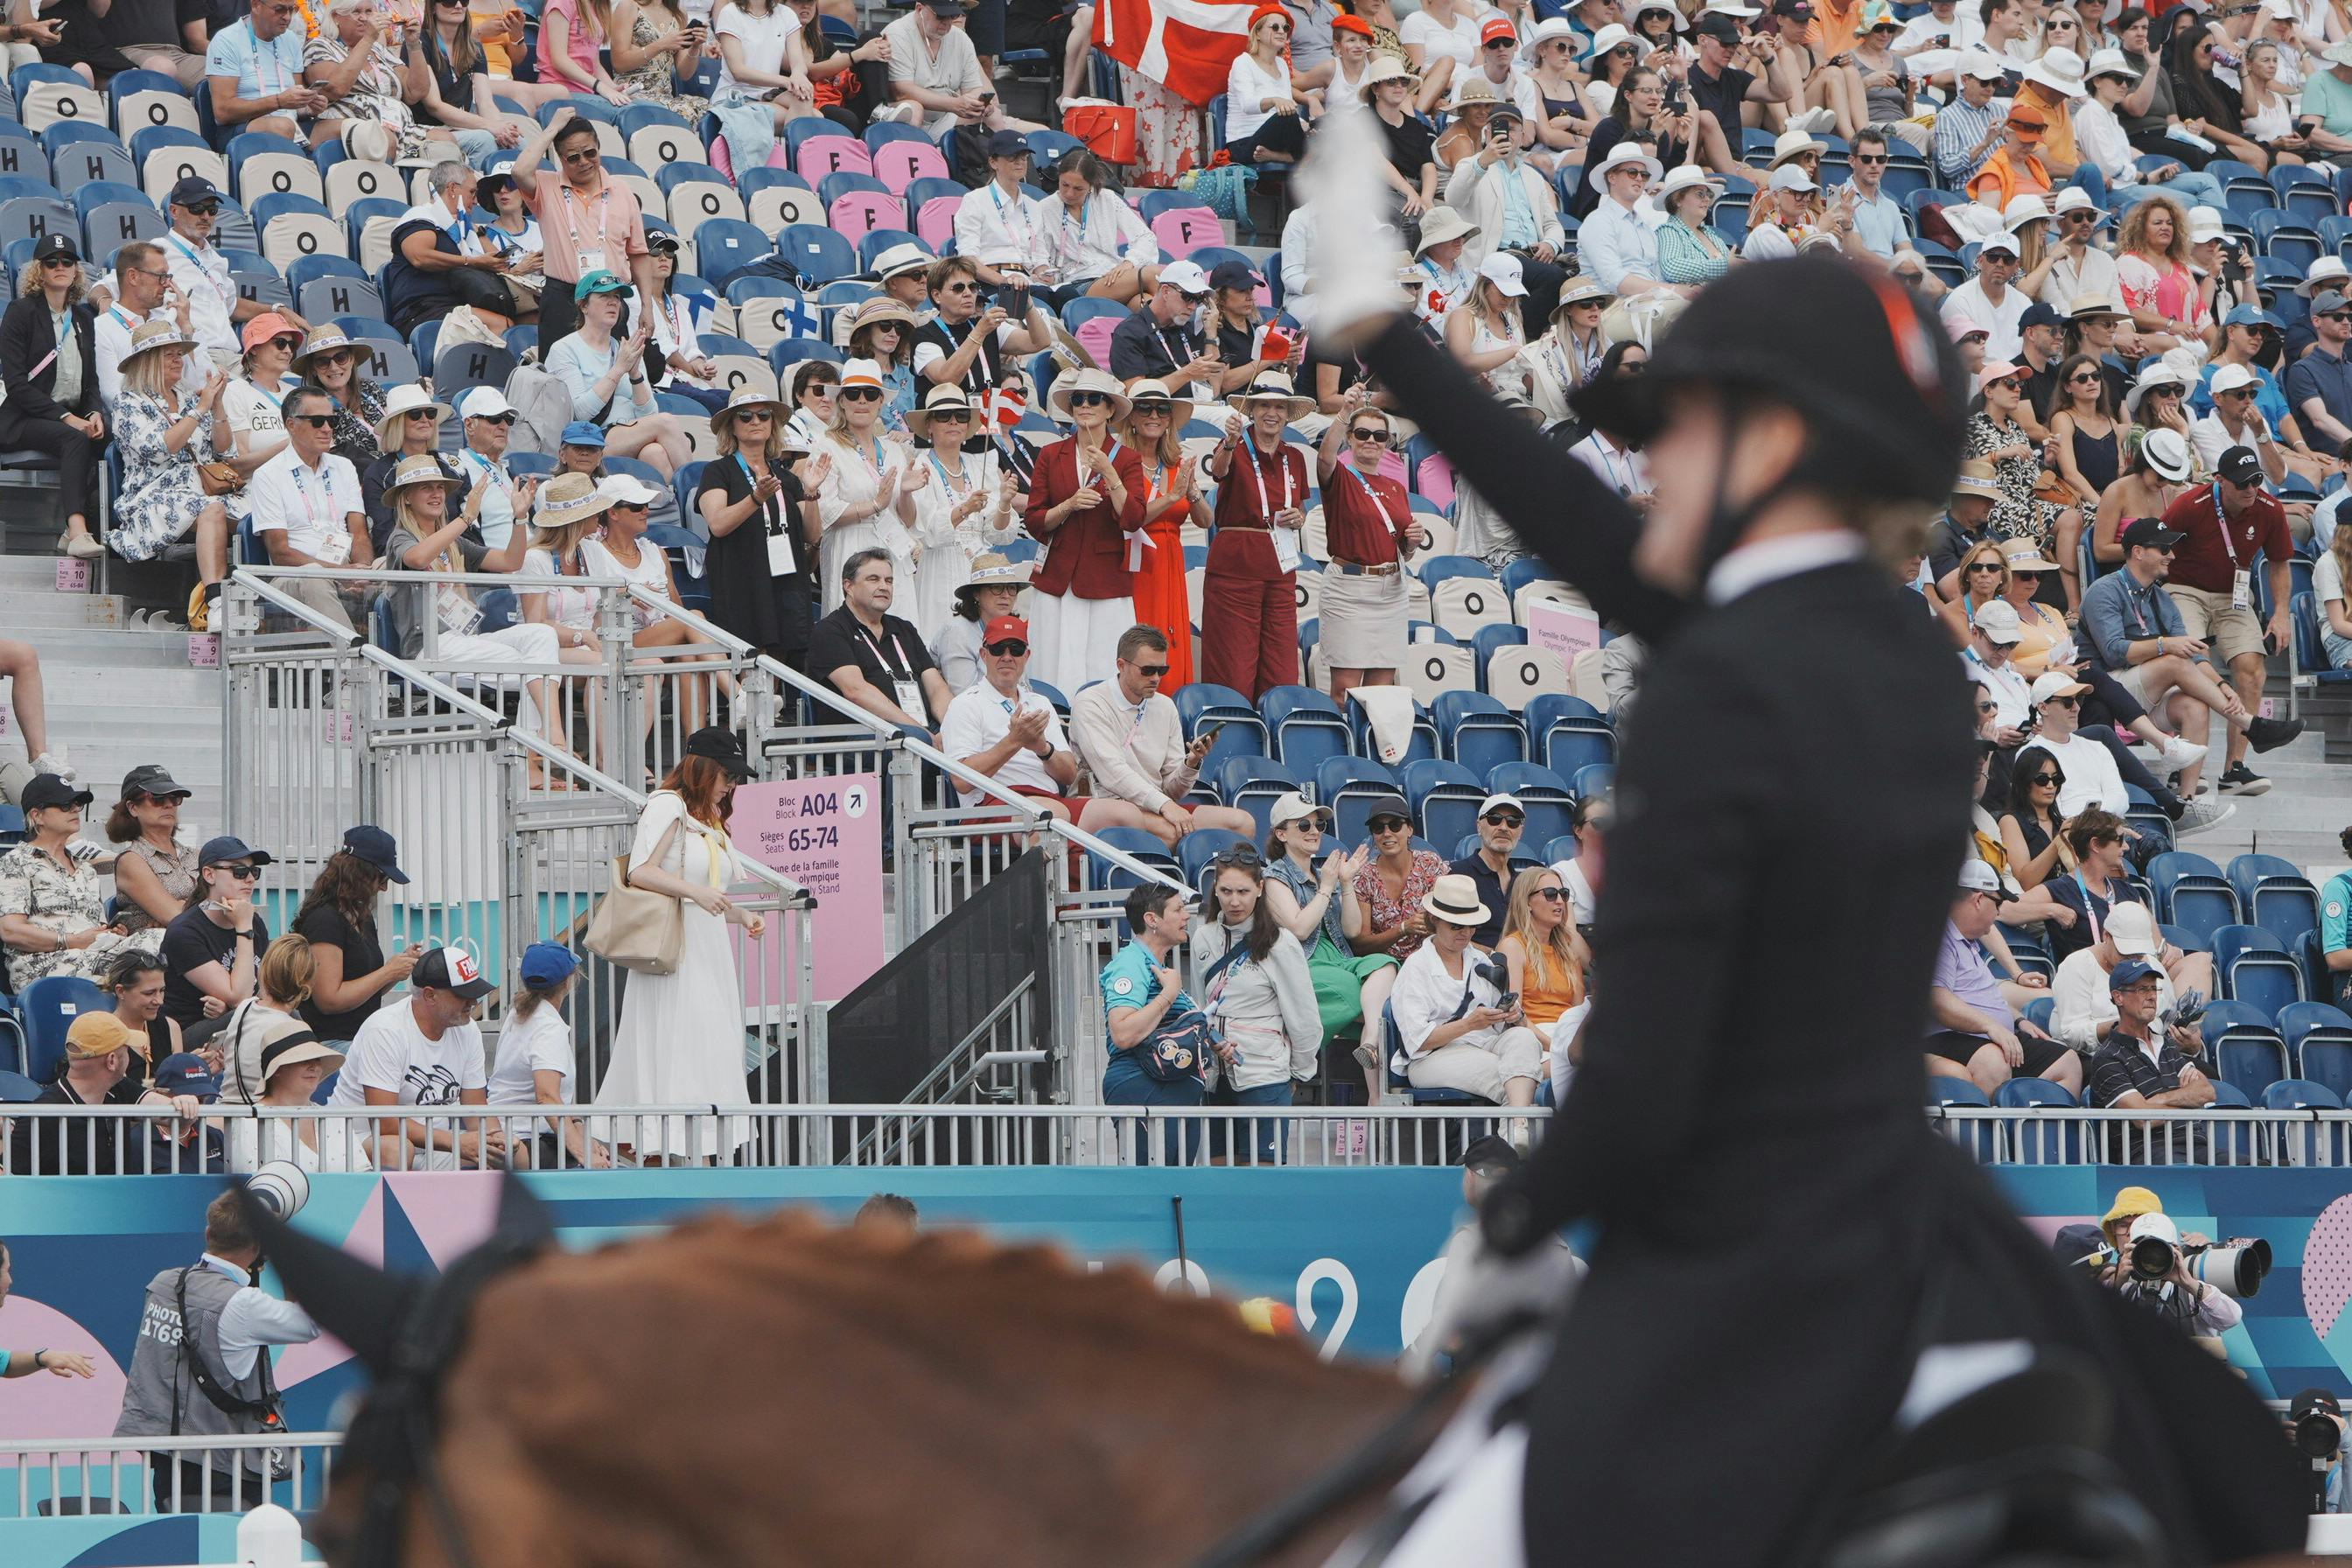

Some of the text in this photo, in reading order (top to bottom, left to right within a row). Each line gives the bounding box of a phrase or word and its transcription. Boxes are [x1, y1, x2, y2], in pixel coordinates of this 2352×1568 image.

[58, 97, 77, 117] O
[149, 102, 168, 125] O
[1, 147, 18, 172] H
[659, 141, 677, 163] O
[830, 152, 840, 172] F
[87, 157, 105, 180] H
[908, 158, 919, 178] F
[273, 172, 291, 193] O
[358, 172, 376, 193] O
[702, 192, 720, 214] O
[780, 202, 798, 223] O
[29, 214, 46, 238] H
[120, 215, 136, 239] H
[865, 208, 876, 231] F
[298, 231, 317, 254] O
[1181, 221, 1192, 244] F
[332, 287, 350, 312] H
[371, 352, 389, 377] H
[469, 354, 489, 379] H
[74, 570, 85, 579] 10
[1465, 593, 1484, 615] O
[1538, 629, 1591, 648] Famille Olympique
[211, 646, 216, 655] 9
[1425, 657, 1446, 681] O
[1520, 662, 1539, 686] O
[2266, 708, 2272, 717] 9
[775, 810, 796, 820] Block
[779, 792, 838, 817] Bloc A04
[760, 825, 839, 851] Sièges 65-74
[765, 844, 785, 854] Seats
[791, 863, 801, 872] de
[802, 862, 810, 871] la
[812, 858, 839, 870] famille
[798, 872, 840, 885] olympique
[818, 884, 840, 895] Stand
[1358, 1134, 1363, 1144] 3
[141, 1317, 184, 1347] 1769
